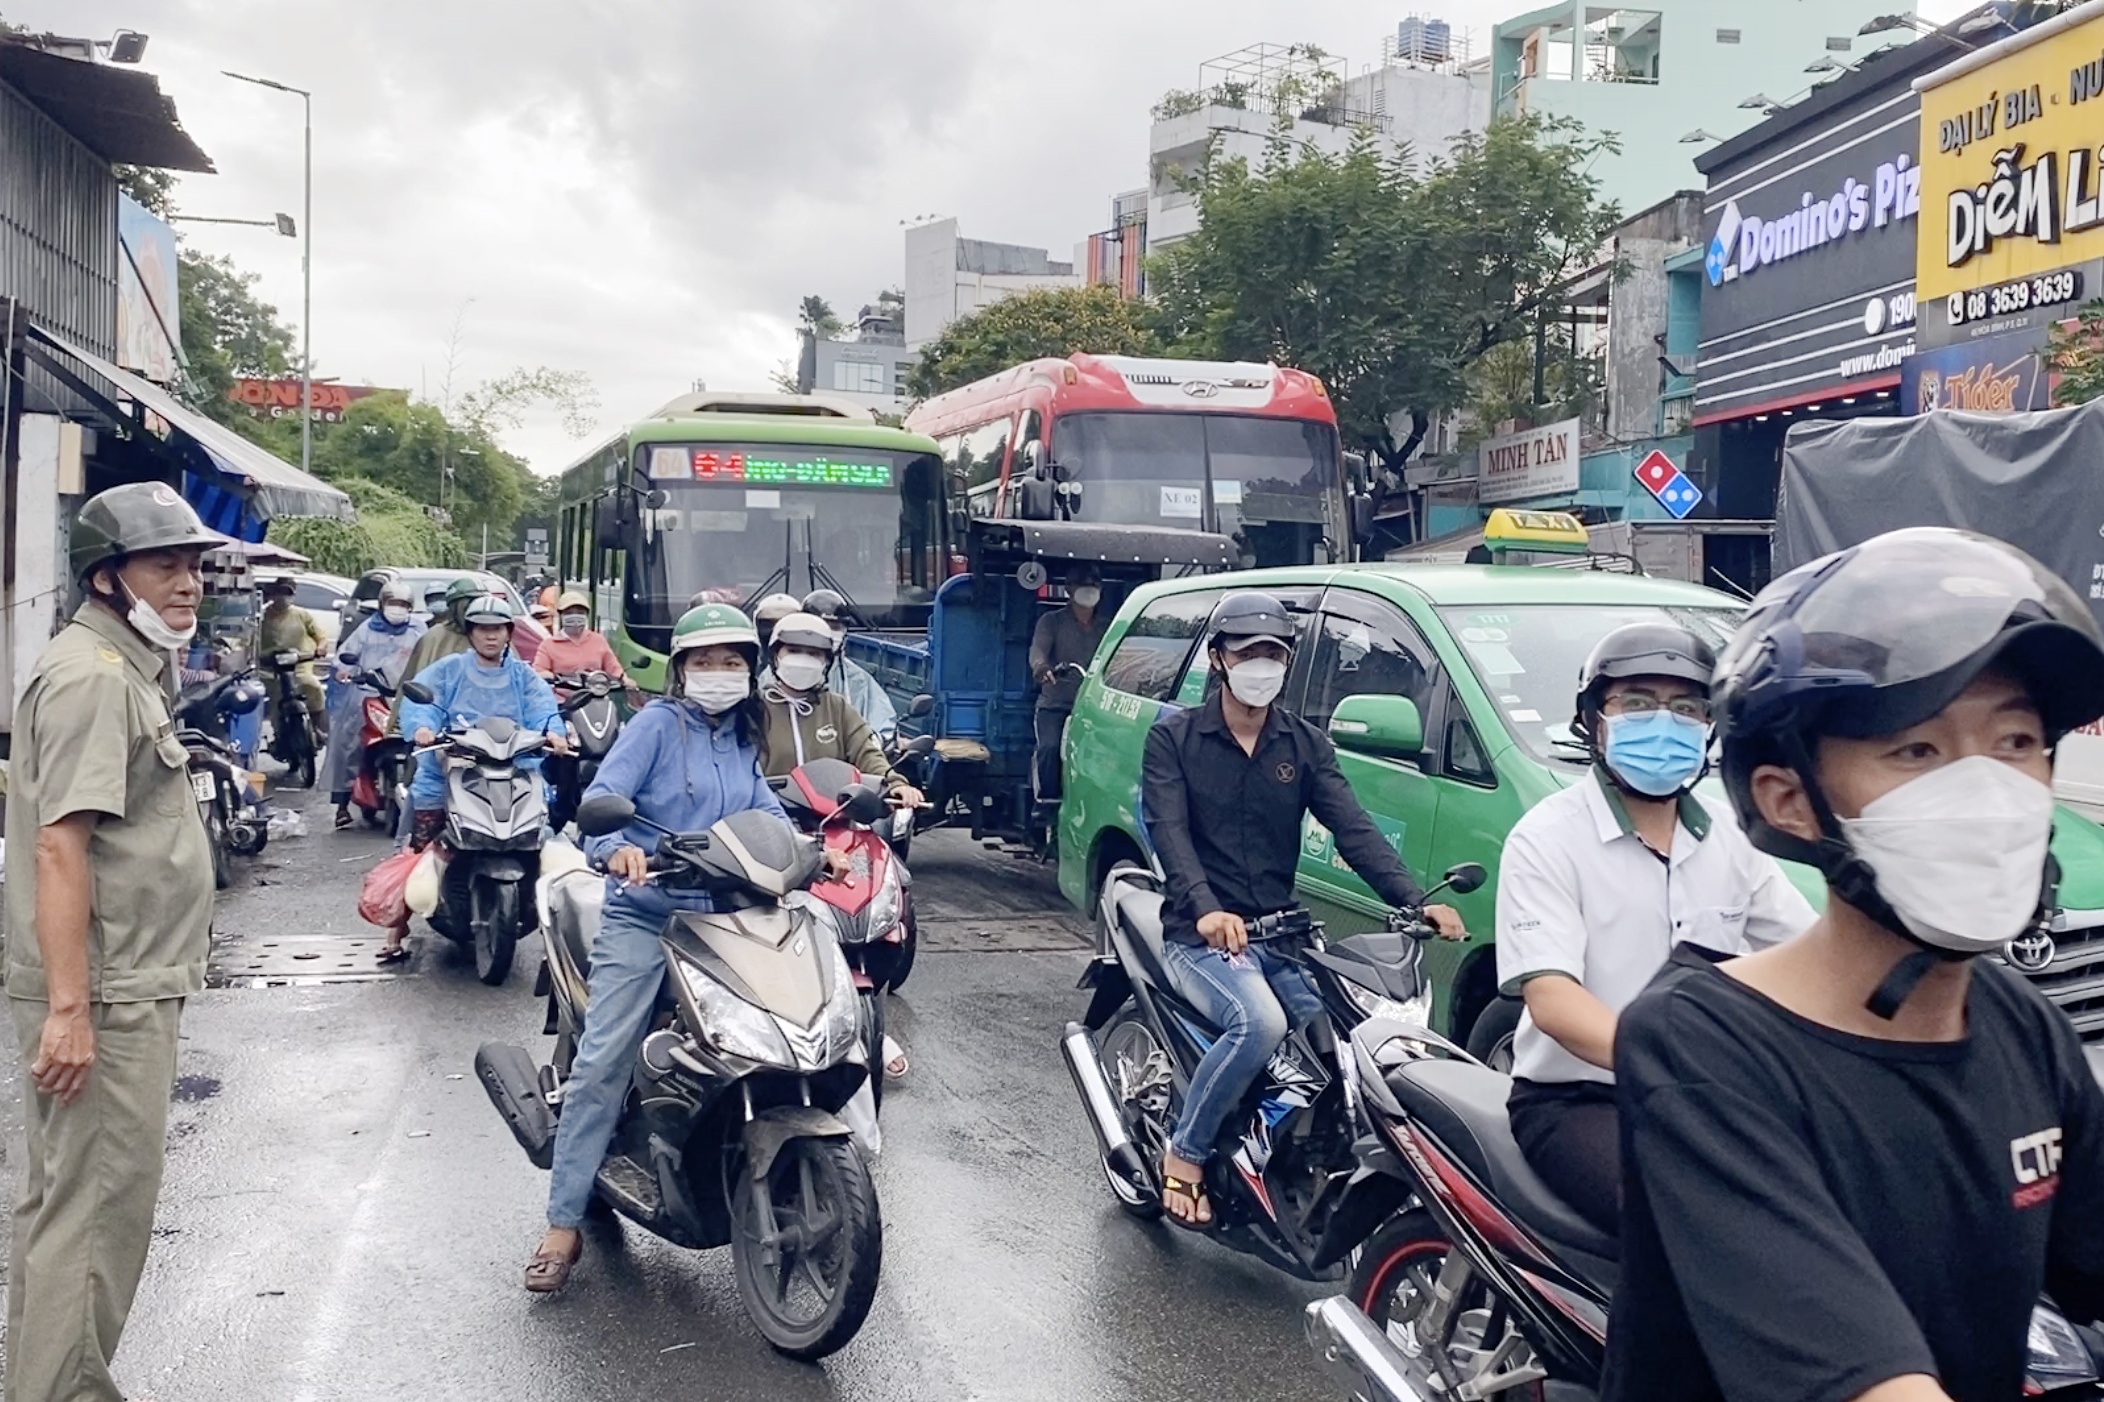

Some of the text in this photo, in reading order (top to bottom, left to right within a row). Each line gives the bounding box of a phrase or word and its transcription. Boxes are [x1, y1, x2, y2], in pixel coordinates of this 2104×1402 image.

[2005, 84, 2042, 129] BIA
[1740, 177, 1869, 273] Domino's
[1967, 271, 2075, 320] 08 3639 3639
[1488, 432, 1568, 475] MINH TÂN
[1508, 512, 1572, 531] TAXI
